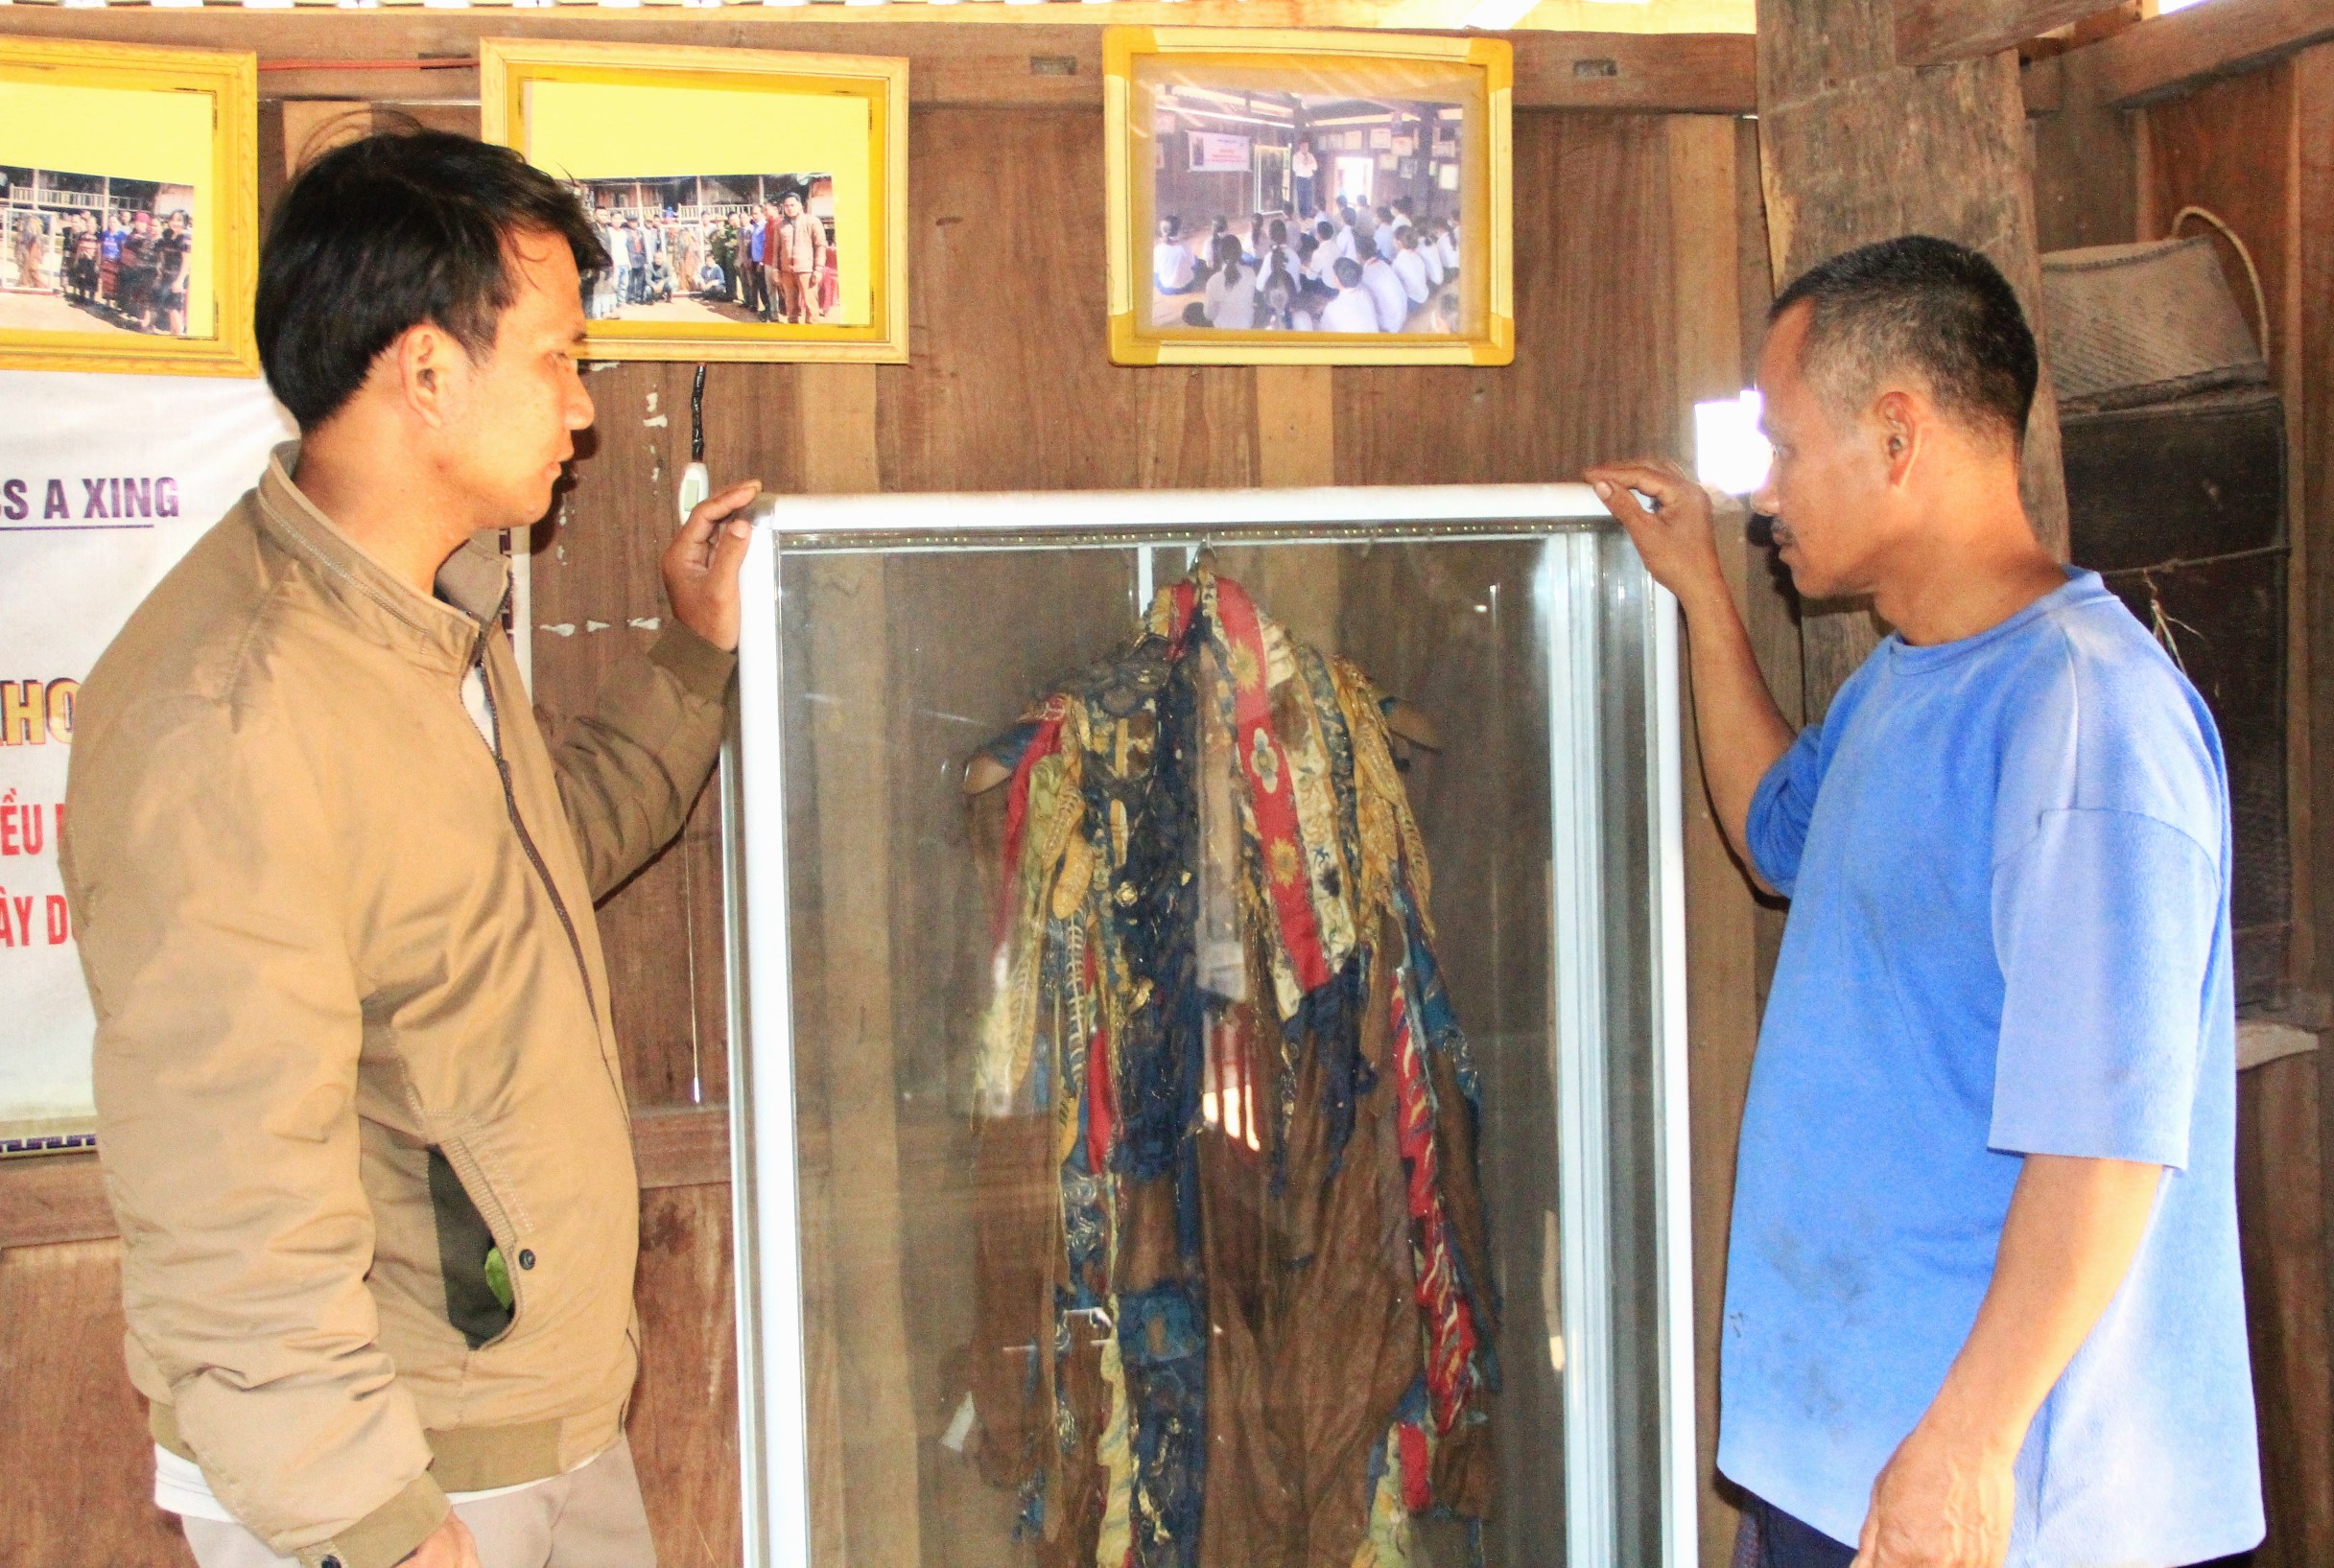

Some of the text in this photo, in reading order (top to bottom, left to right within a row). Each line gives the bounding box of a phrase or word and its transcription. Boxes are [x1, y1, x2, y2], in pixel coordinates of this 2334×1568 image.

[0, 476, 179, 521] S A XING
[0, 677, 81, 746] HO
